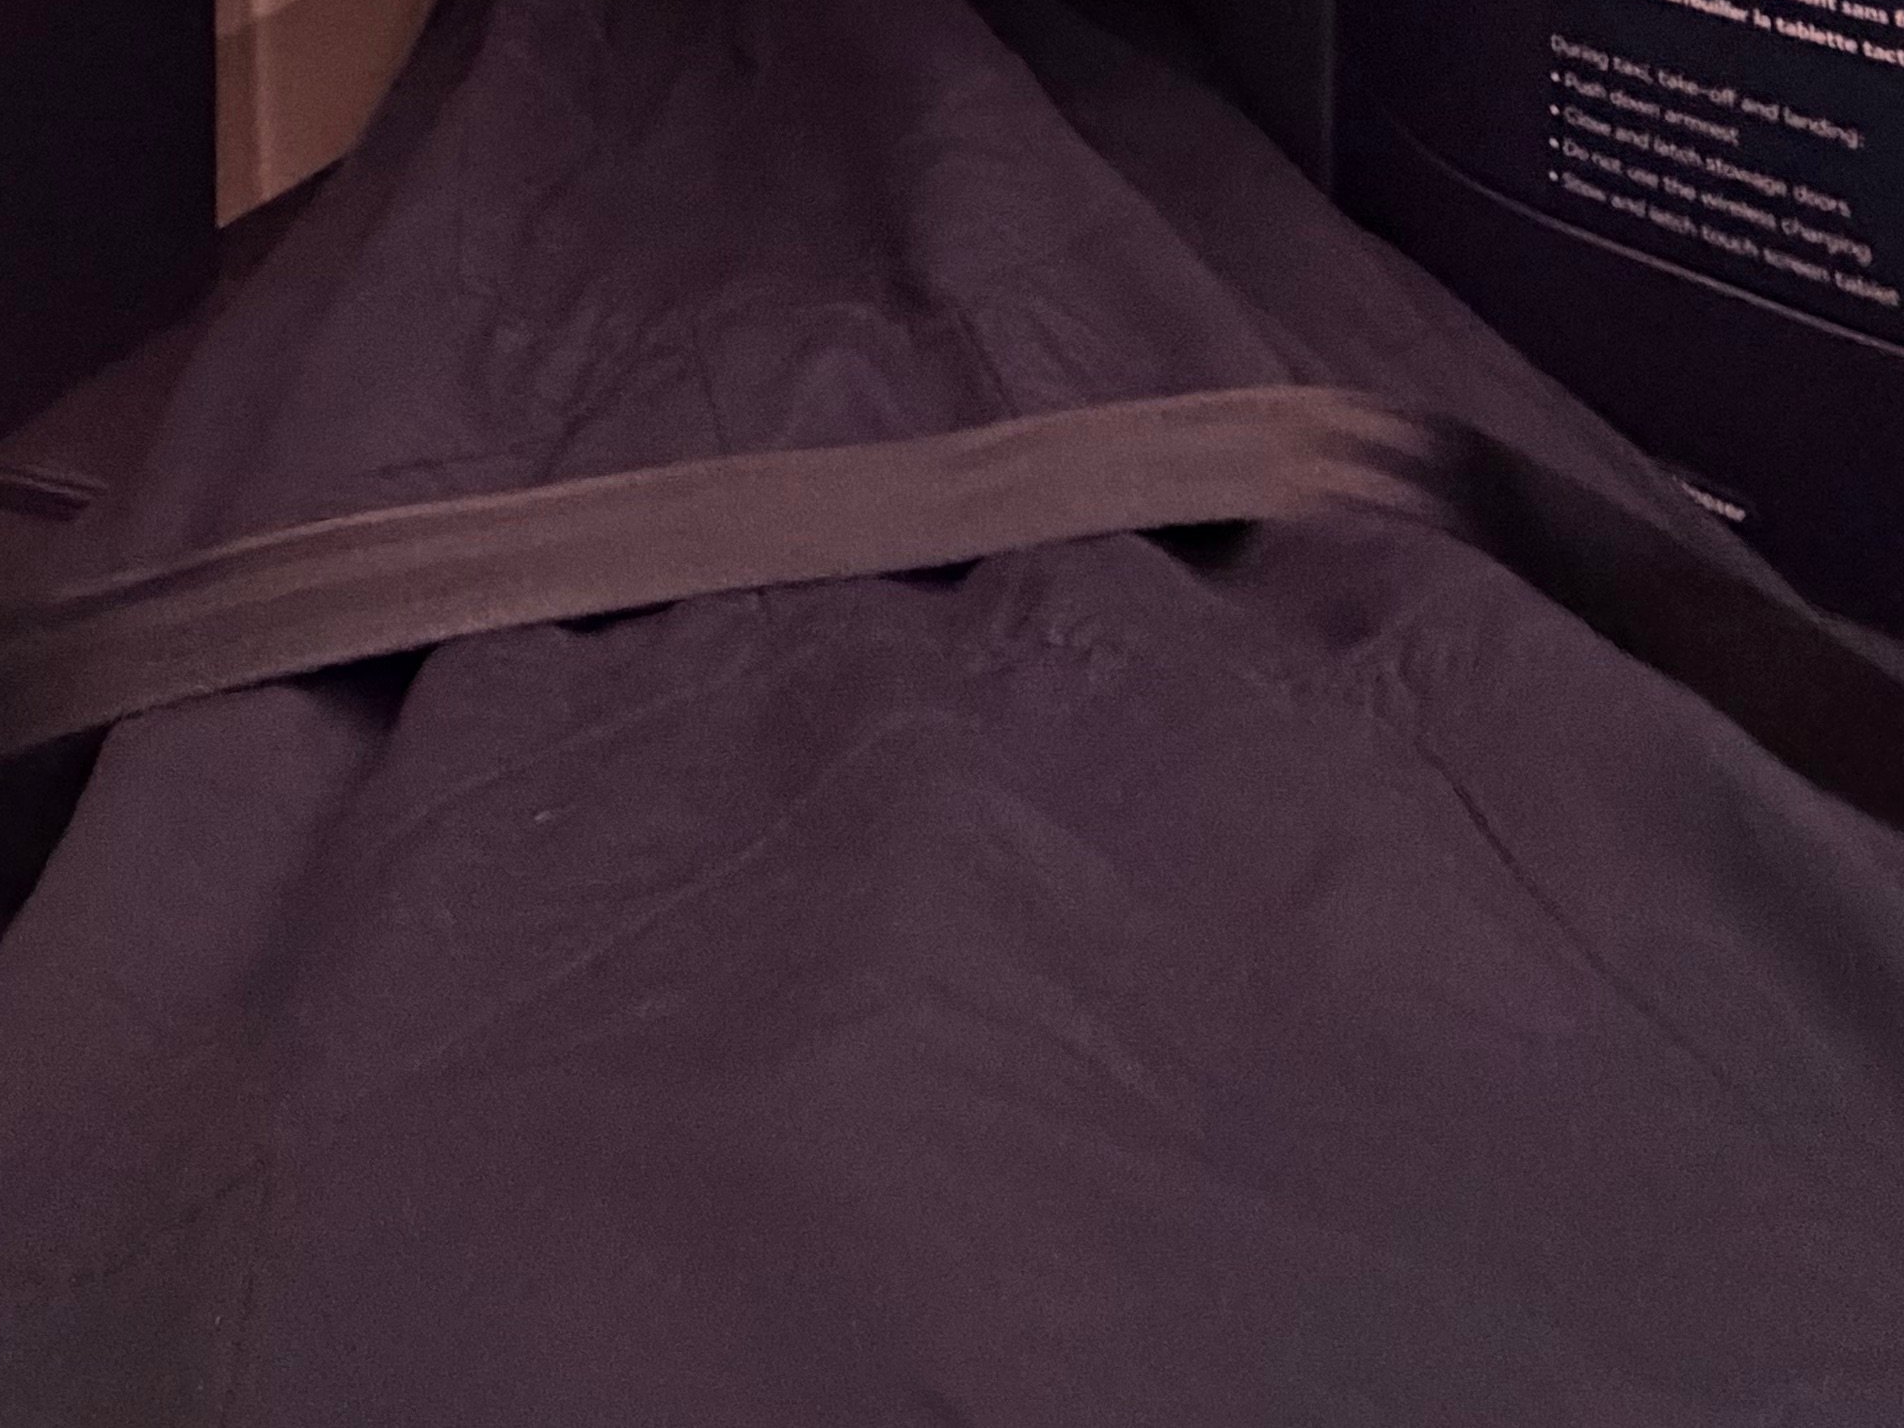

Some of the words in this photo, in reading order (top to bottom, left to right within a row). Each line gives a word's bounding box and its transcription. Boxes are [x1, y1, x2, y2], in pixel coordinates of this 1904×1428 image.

[1842, 1, 1889, 25] sans
[1753, 8, 1771, 30] la
[1776, 17, 1858, 55] tablette
[1741, 97, 1780, 121] and
[1563, 138, 1590, 162] Do
